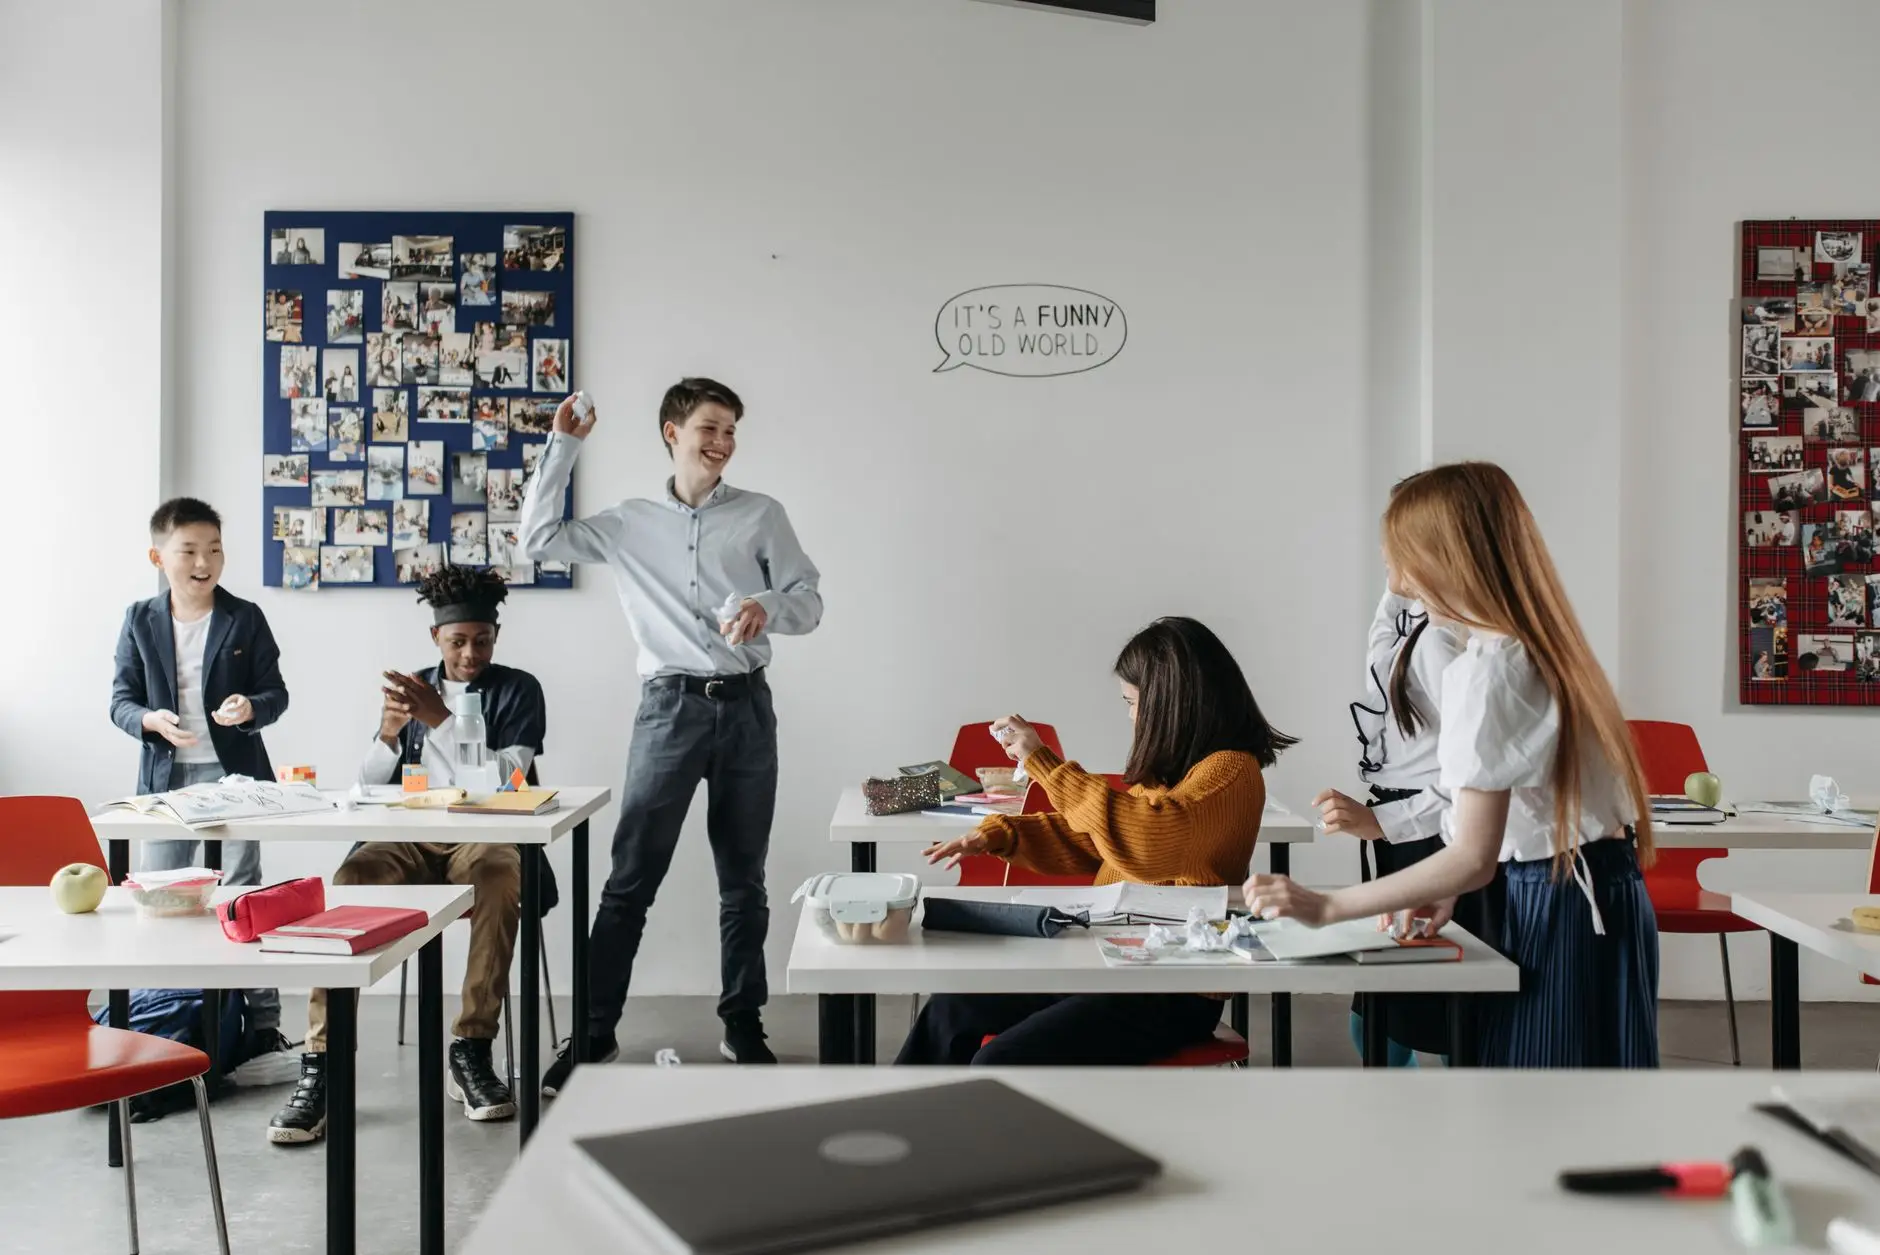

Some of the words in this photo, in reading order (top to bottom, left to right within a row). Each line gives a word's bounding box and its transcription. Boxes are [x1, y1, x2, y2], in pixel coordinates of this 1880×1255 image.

[954, 304, 1002, 330] IT'S
[1014, 305, 1027, 328] A
[1038, 304, 1115, 328] FUNNY
[958, 333, 1006, 356] OLD
